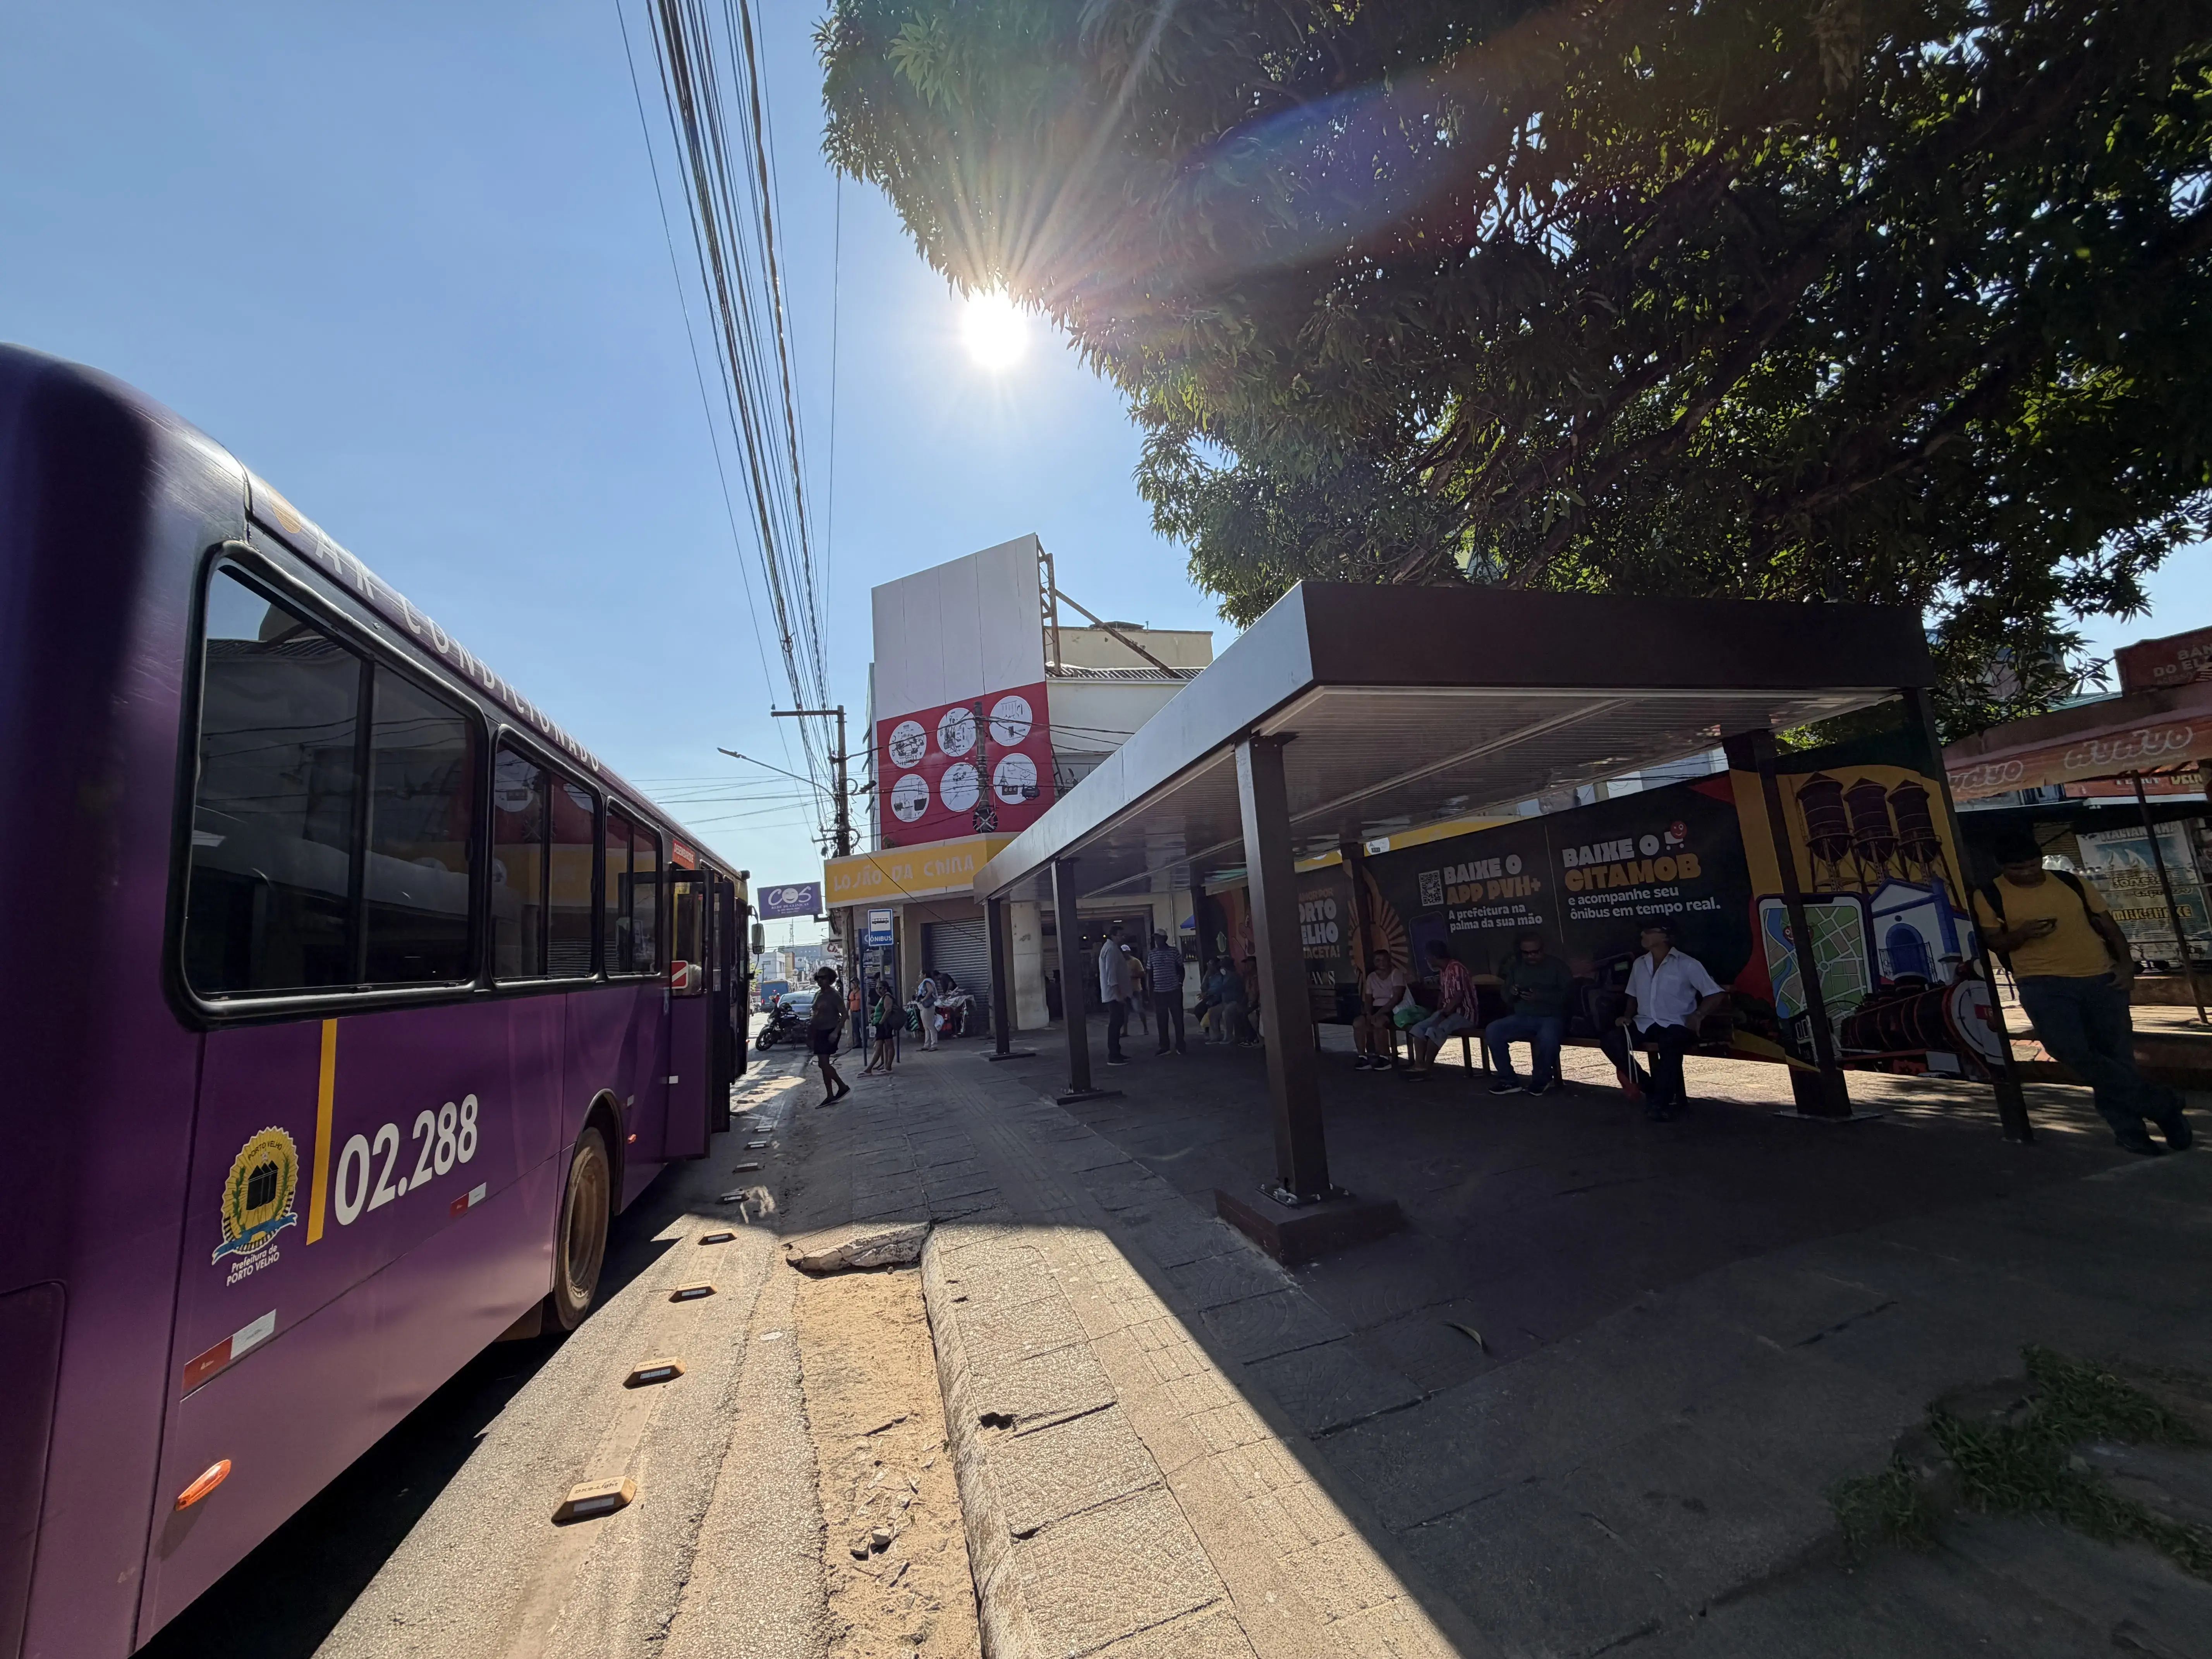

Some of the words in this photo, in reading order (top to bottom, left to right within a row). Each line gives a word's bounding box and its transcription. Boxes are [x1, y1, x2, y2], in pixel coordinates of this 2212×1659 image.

[315, 527, 376, 599] AR
[398, 592, 599, 772] CONDICIONADO
[1562, 838, 1635, 867] BAIXE
[1639, 834, 1659, 856] O
[1444, 857, 1502, 885] BAIXE
[1506, 854, 1522, 875] O
[1565, 852, 1701, 891] CITAMOB
[1446, 883, 1483, 905] APP
[1487, 875, 1541, 900] PVH+
[1568, 897, 1575, 906] e
[1578, 888, 1651, 905] acompanhe
[1654, 887, 1679, 897] seu
[1298, 898, 1336, 924] ORTO
[1449, 910, 1455, 920] A
[1456, 905, 1510, 921] prefeitura
[1511, 904, 1526, 914] na
[1570, 907, 1610, 919] ônibus
[1613, 907, 1634, 917] em
[1636, 902, 1683, 916] tempo
[1686, 896, 1721, 911] real.
[1301, 921, 1338, 945] ELHO
[1450, 921, 1479, 933] palma
[1481, 918, 1494, 928] da
[1496, 917, 1515, 927] sua
[1518, 913, 1542, 926] mão
[248, 1142, 266, 1161] PORTO
[267, 1140, 282, 1150] VELHO
[335, 1093, 478, 1226] 02.288
[226, 1264, 254, 1287] PORTO
[256, 1252, 280, 1271] VELHO
[231, 1250, 267, 1273] Prefeitura
[269, 1243, 277, 1254] de
